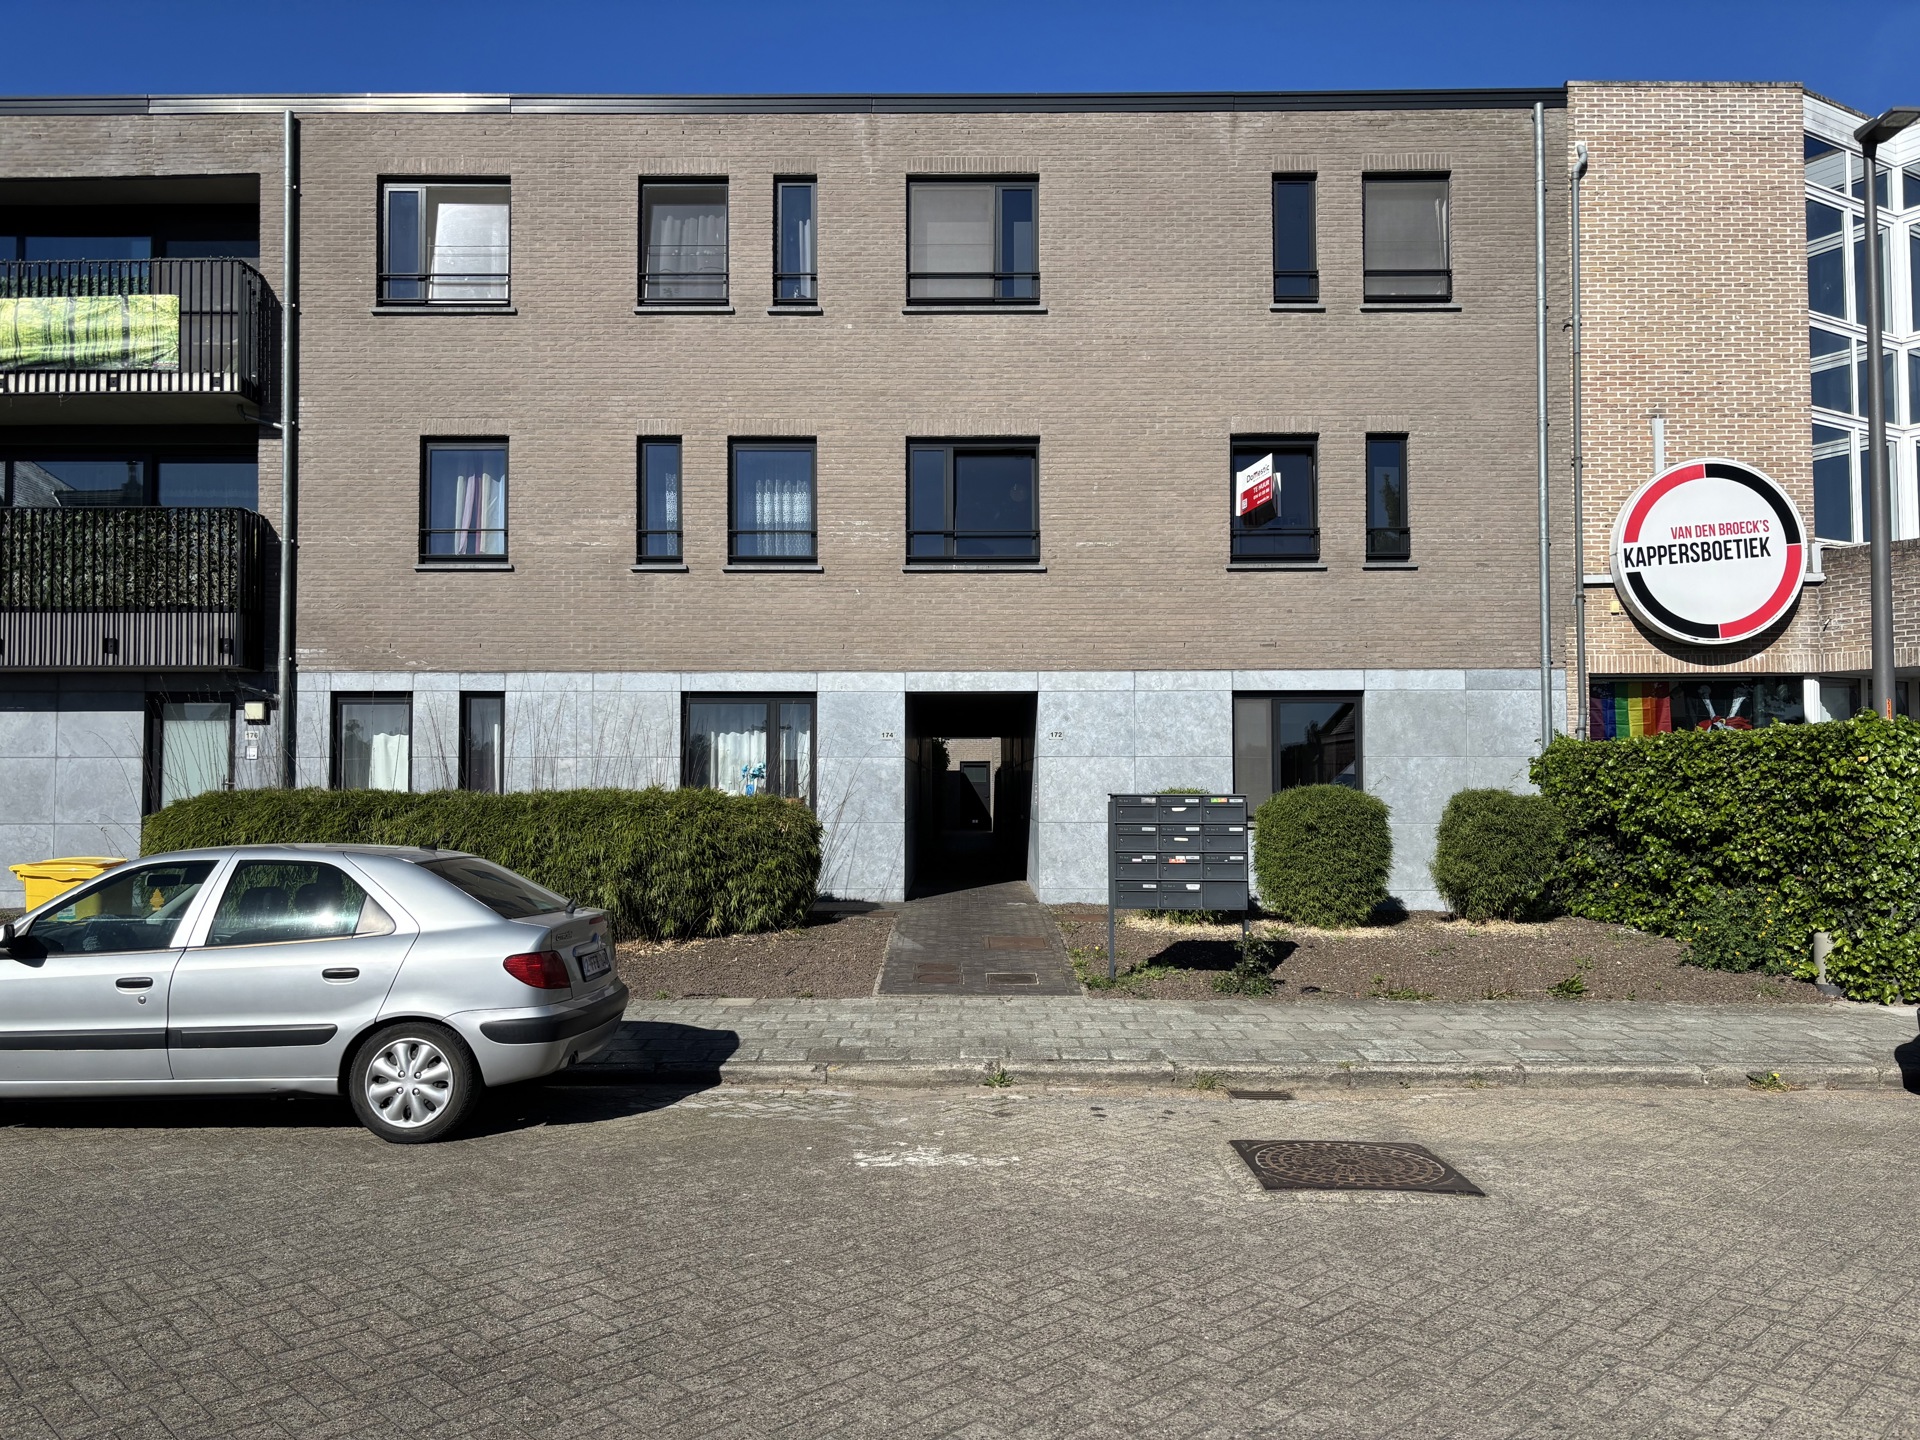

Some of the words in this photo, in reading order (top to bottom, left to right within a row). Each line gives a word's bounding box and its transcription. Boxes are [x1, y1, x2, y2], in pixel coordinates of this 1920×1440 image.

[1670, 526, 1692, 540] VAN
[1694, 523, 1716, 538] DEN
[1719, 519, 1770, 537] BROECK'S
[1623, 536, 1771, 569] KAPPERSBOETIEK
